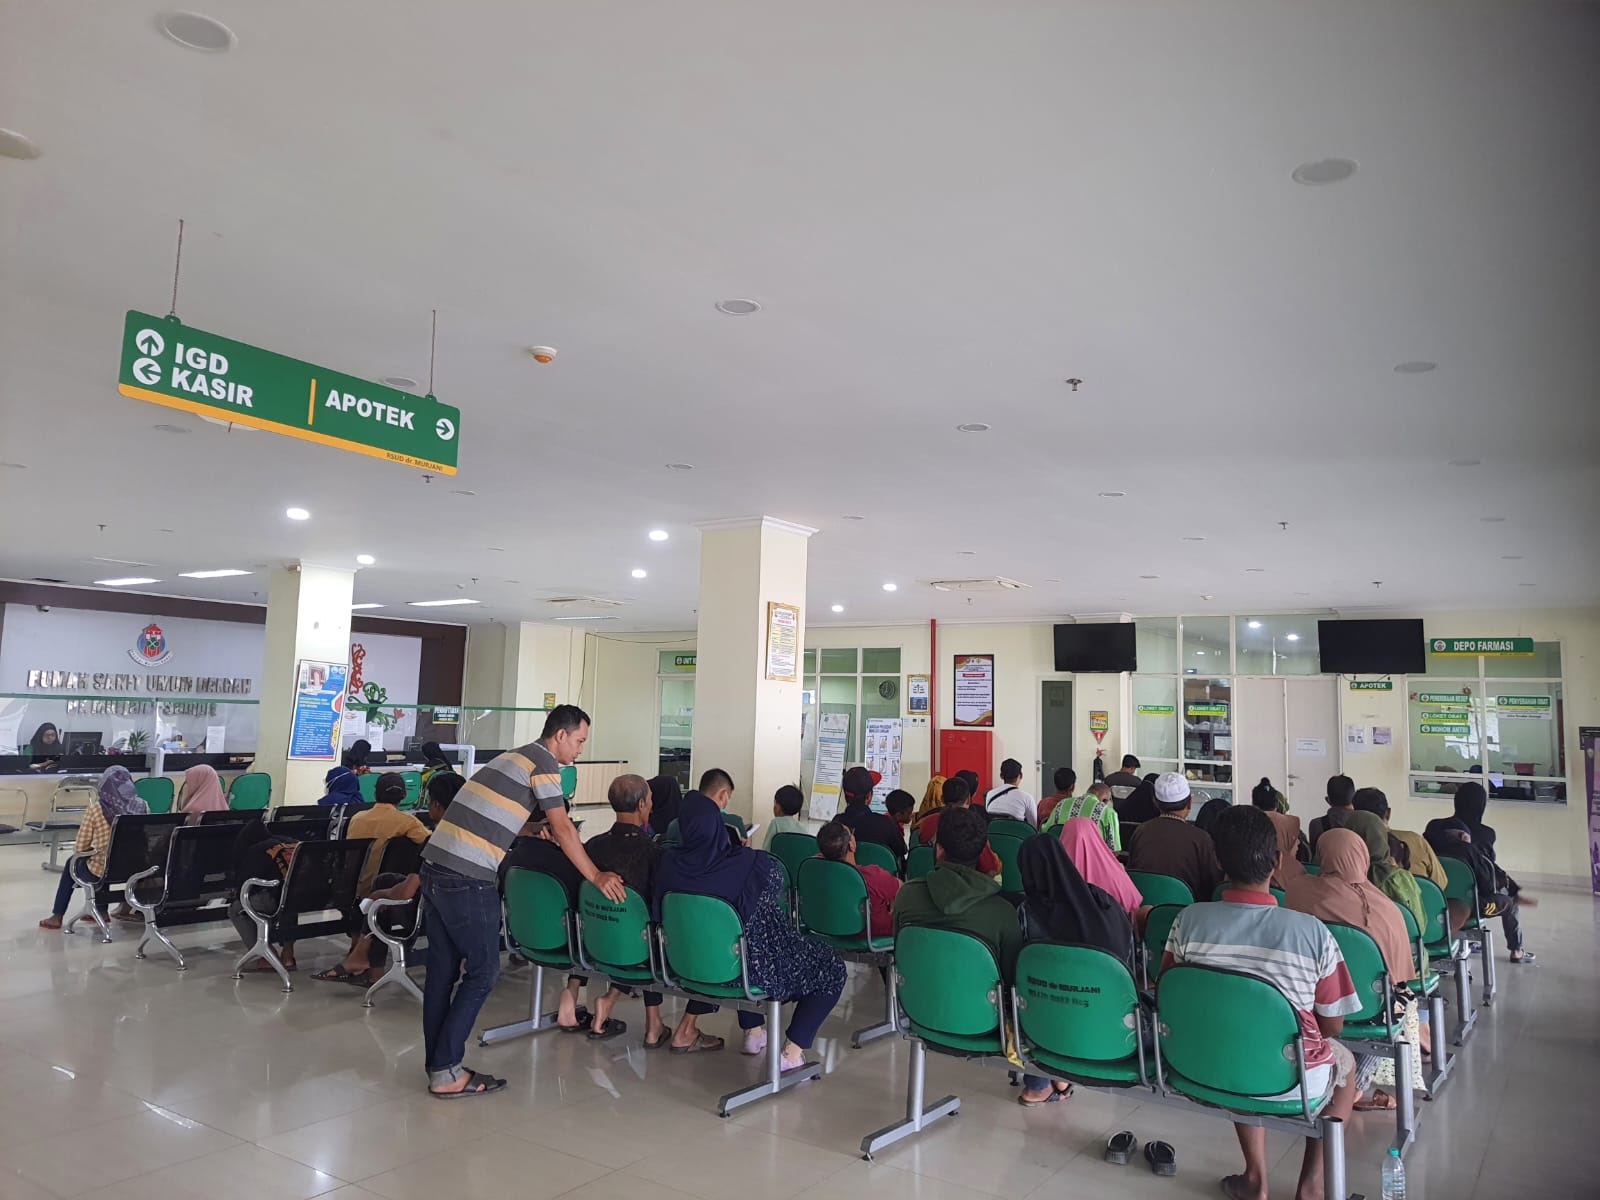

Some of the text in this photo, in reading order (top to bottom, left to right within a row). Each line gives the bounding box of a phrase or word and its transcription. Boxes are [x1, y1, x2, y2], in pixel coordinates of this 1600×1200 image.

[174, 342, 229, 375] IGD
[171, 367, 253, 408] KASIR
[325, 390, 415, 430] APOTEK
[386, 452, 404, 462] RSUD
[1453, 641, 1514, 651] DEPO FARMASI
